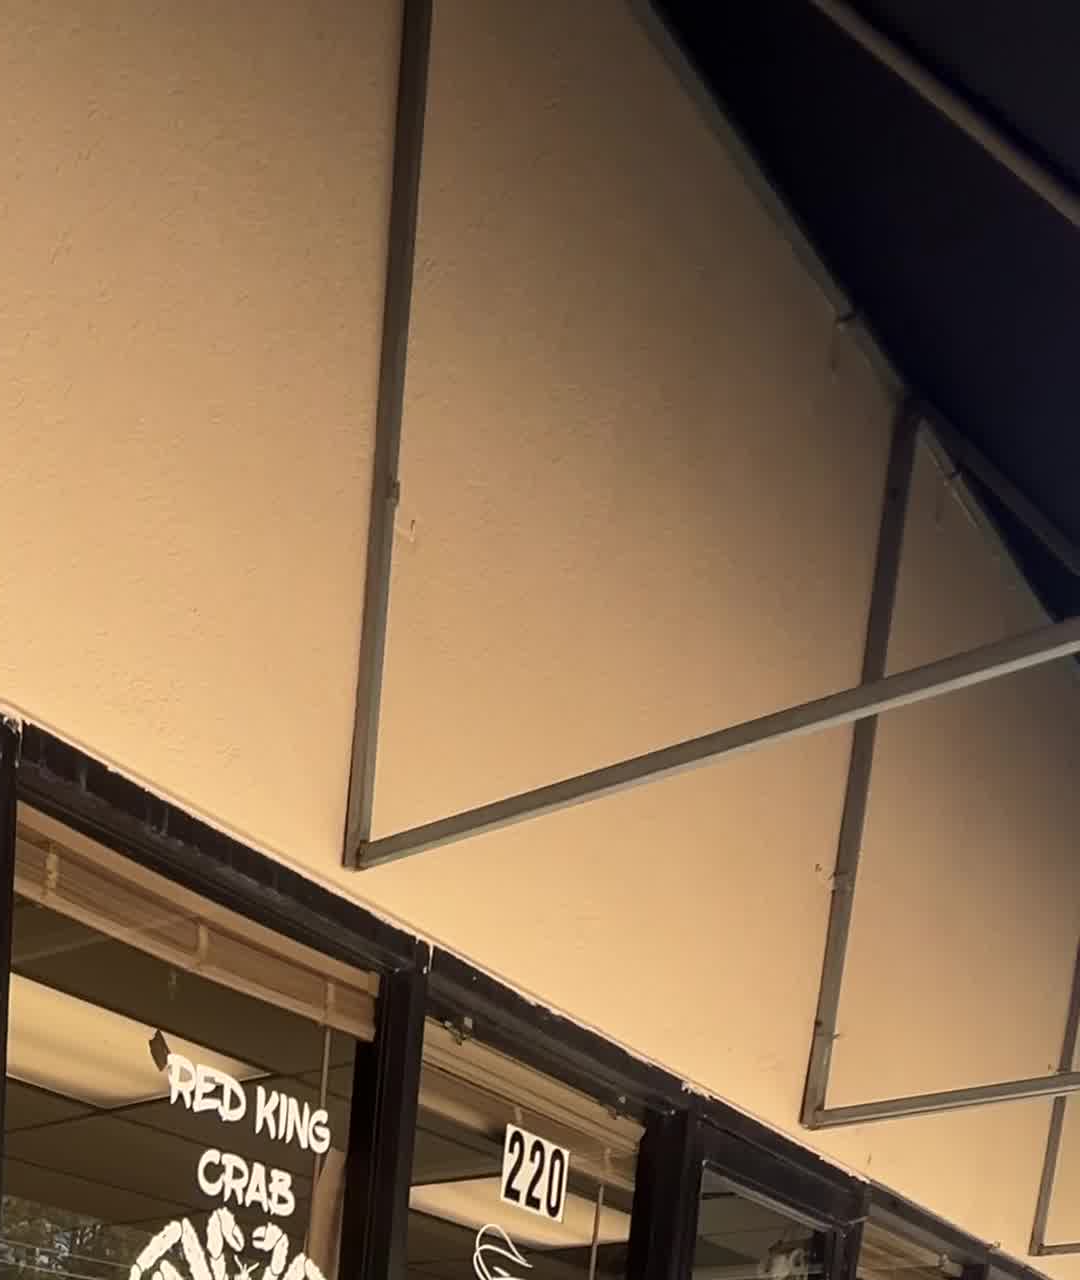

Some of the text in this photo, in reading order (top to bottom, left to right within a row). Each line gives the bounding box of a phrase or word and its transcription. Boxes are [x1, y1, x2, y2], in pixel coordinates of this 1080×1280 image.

[167, 1053, 331, 1154] RED KING
[197, 1149, 296, 1217] CRAB
[503, 1130, 565, 1218] 220
